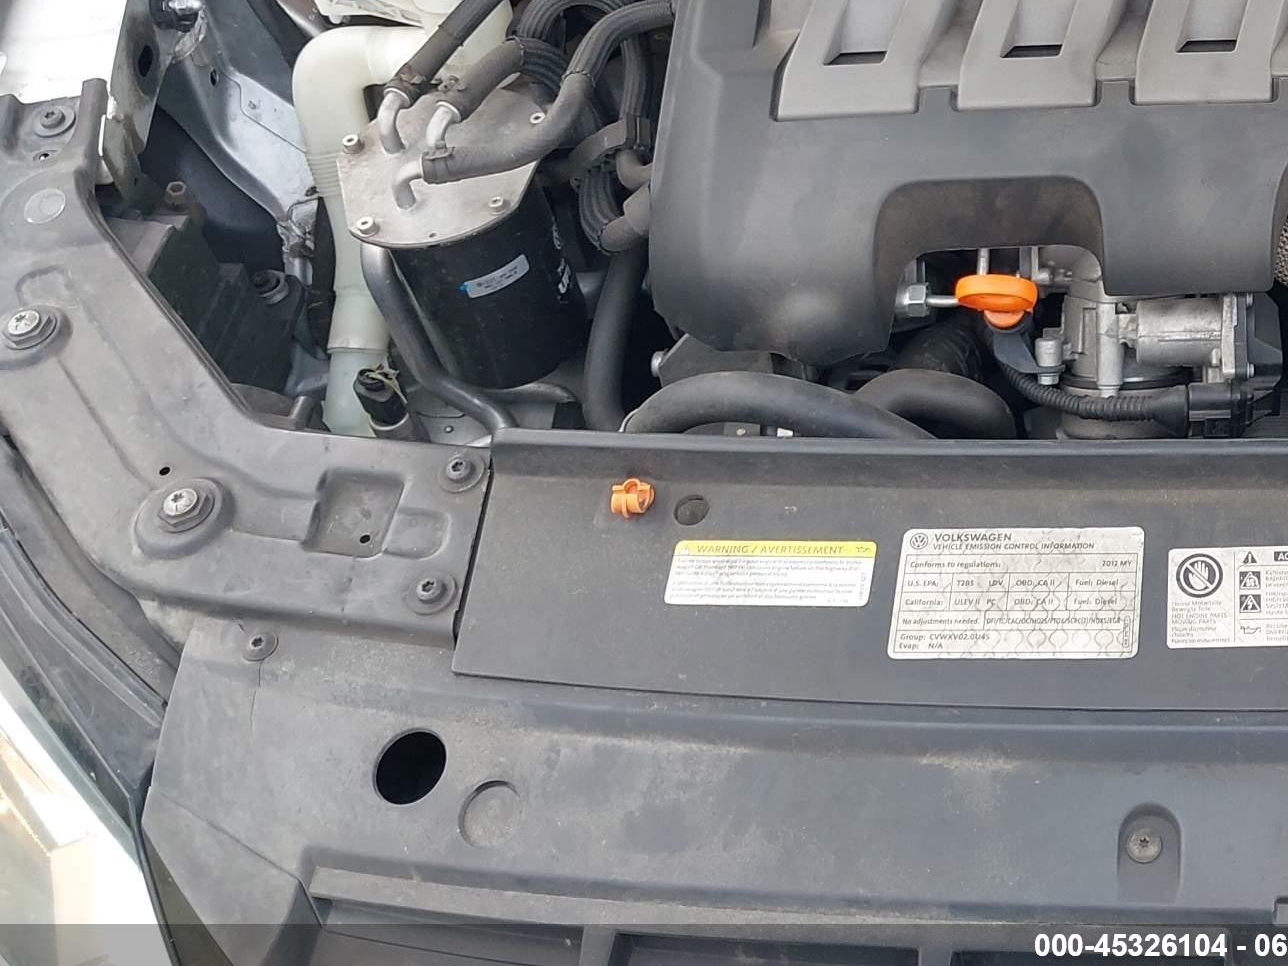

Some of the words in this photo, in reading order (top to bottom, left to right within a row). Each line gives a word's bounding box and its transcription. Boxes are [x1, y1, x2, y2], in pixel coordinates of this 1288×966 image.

[934, 533, 1012, 542] VOLKSWAGEN
[697, 545, 750, 555] WARNING
[760, 545, 844, 555] AVERTISSEMENT
[933, 543, 963, 551] VEHICLE
[1004, 542, 1038, 550] CONTROL
[1041, 542, 1095, 550] INFORMATION
[910, 561, 945, 569] Conforms
[1102, 559, 1118, 567] 2012
[1119, 559, 1133, 567] MY
[1075, 578, 1093, 587] Fuel:
[1096, 578, 1119, 586] Diesel
[904, 598, 943, 607] California:
[954, 598, 974, 606] ULEV
[1073, 597, 1091, 606] Fuel:
[1095, 597, 1117, 606] Diesel
[902, 617, 912, 625] No
[913, 617, 952, 627] adjustments
[900, 633, 926, 643] Group:
[899, 643, 919, 652] Evap:
[928, 642, 944, 650] N/A
